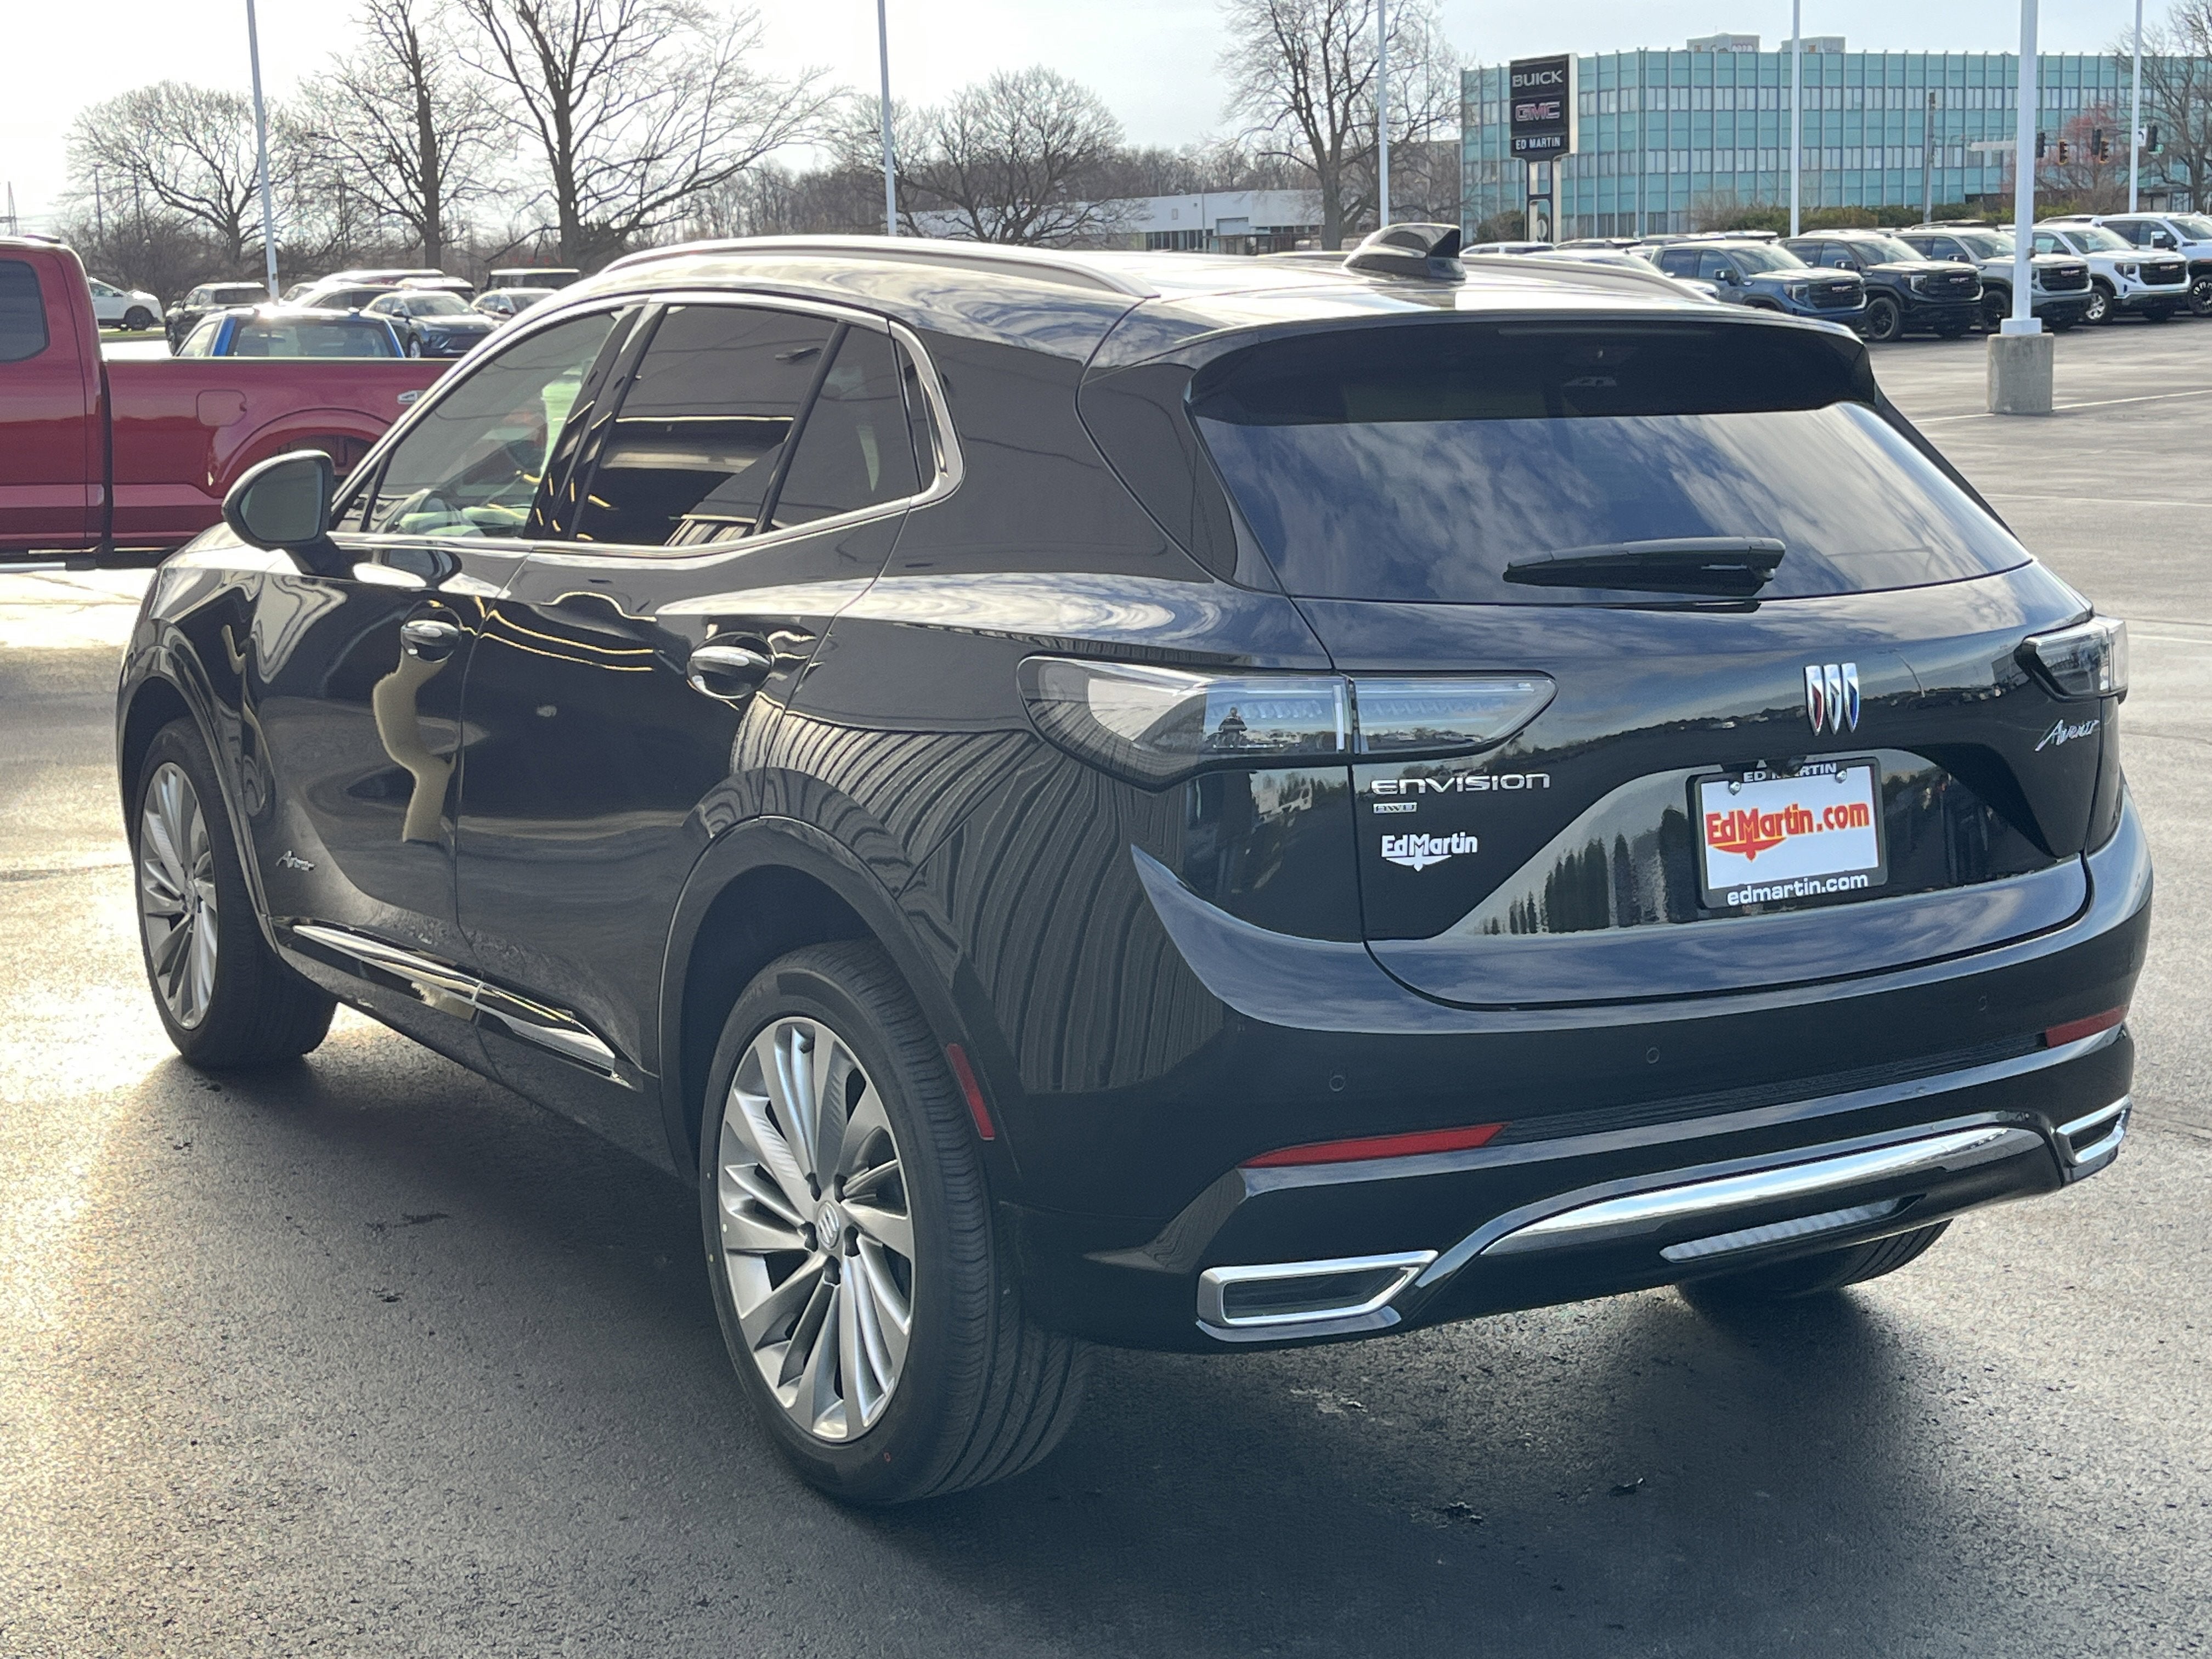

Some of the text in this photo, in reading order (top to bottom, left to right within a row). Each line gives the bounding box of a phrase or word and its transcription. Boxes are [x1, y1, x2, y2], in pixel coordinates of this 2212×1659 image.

[1512, 70, 1563, 87] BUICK
[1515, 101, 1561, 122] GMC
[1515, 137, 1561, 150] ED MARTIN
[1743, 762, 1837, 782] ED RTIN
[1381, 832, 1478, 857] EdMartin
[1727, 874, 1869, 906] edmartin.com
